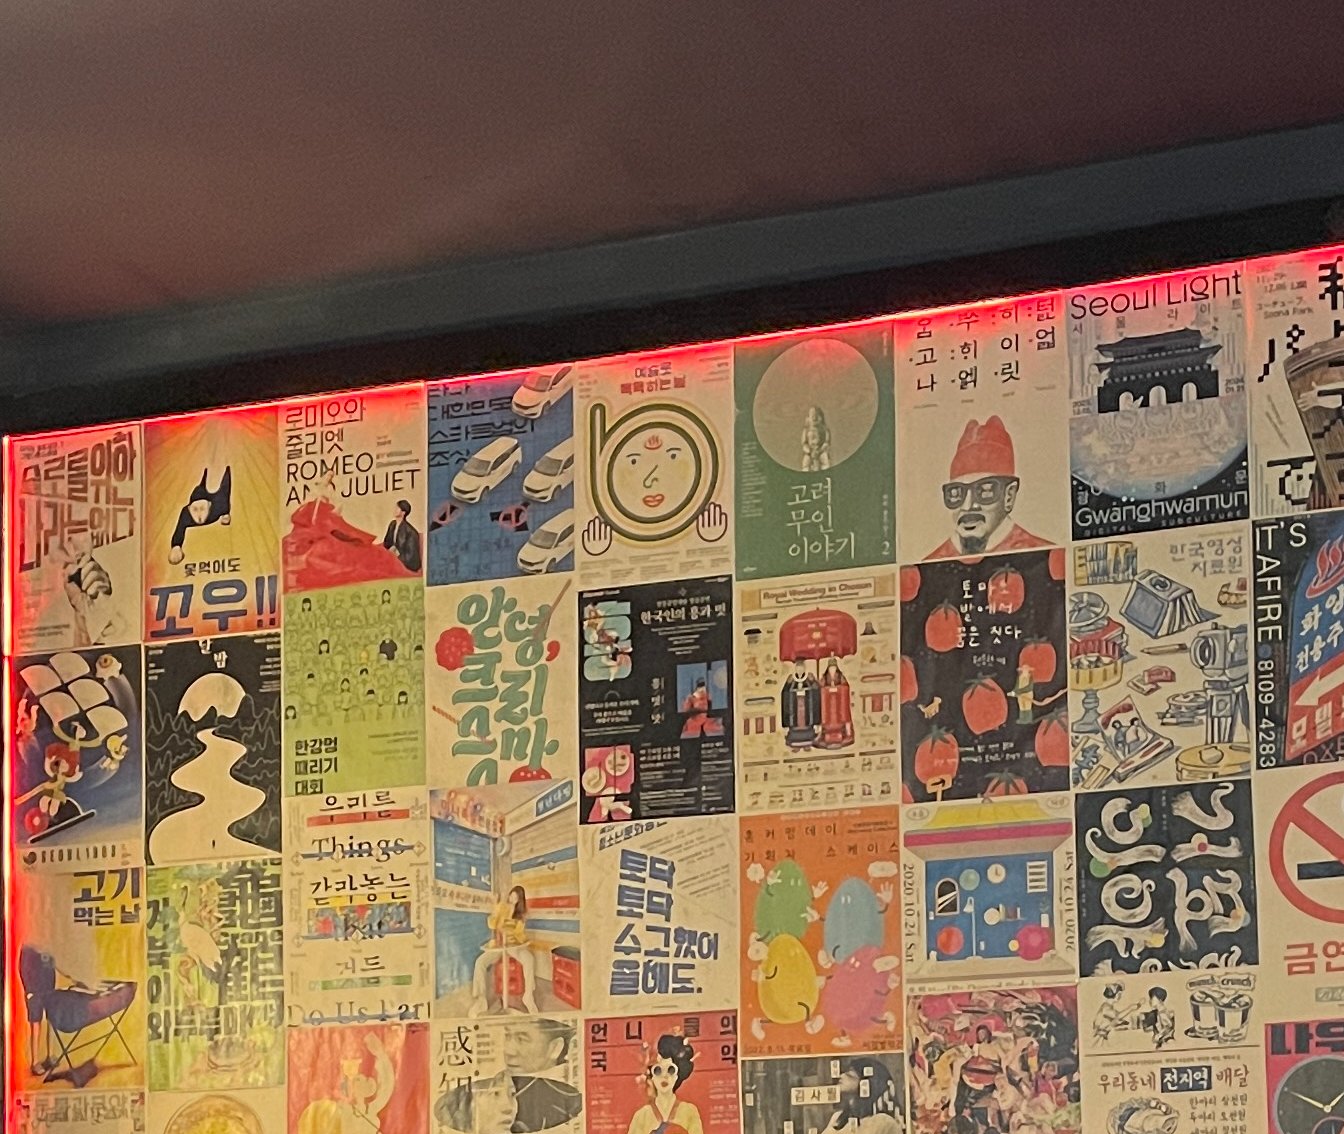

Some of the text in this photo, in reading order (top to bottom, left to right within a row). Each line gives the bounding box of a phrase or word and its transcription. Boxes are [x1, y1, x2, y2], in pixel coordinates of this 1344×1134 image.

[1071, 283, 1156, 320] Seoul
[1166, 270, 1242, 306] Light
[285, 397, 367, 431] 로미오와
[286, 428, 345, 459] 줄리엣
[287, 452, 374, 484] ROMEO
[340, 468, 421, 499] JULIET
[787, 477, 832, 506] 고려
[787, 505, 834, 536] 무인
[1075, 490, 1248, 527] Gwanghwamun
[788, 532, 855, 564] 이야기
[881, 541, 890, 555] 2
[1256, 522, 1307, 551] IT'S
[1256, 554, 1283, 643] AFIRE
[1257, 659, 1277, 768] 8109-4283
[295, 778, 324, 796] 대회
[311, 835, 408, 863] Things
[73, 867, 140, 903] 고기
[903, 864, 915, 897] 2020
[73, 907, 114, 927] 먹는
[1097, 1064, 1250, 1094] 우리동네 전지역 배달
